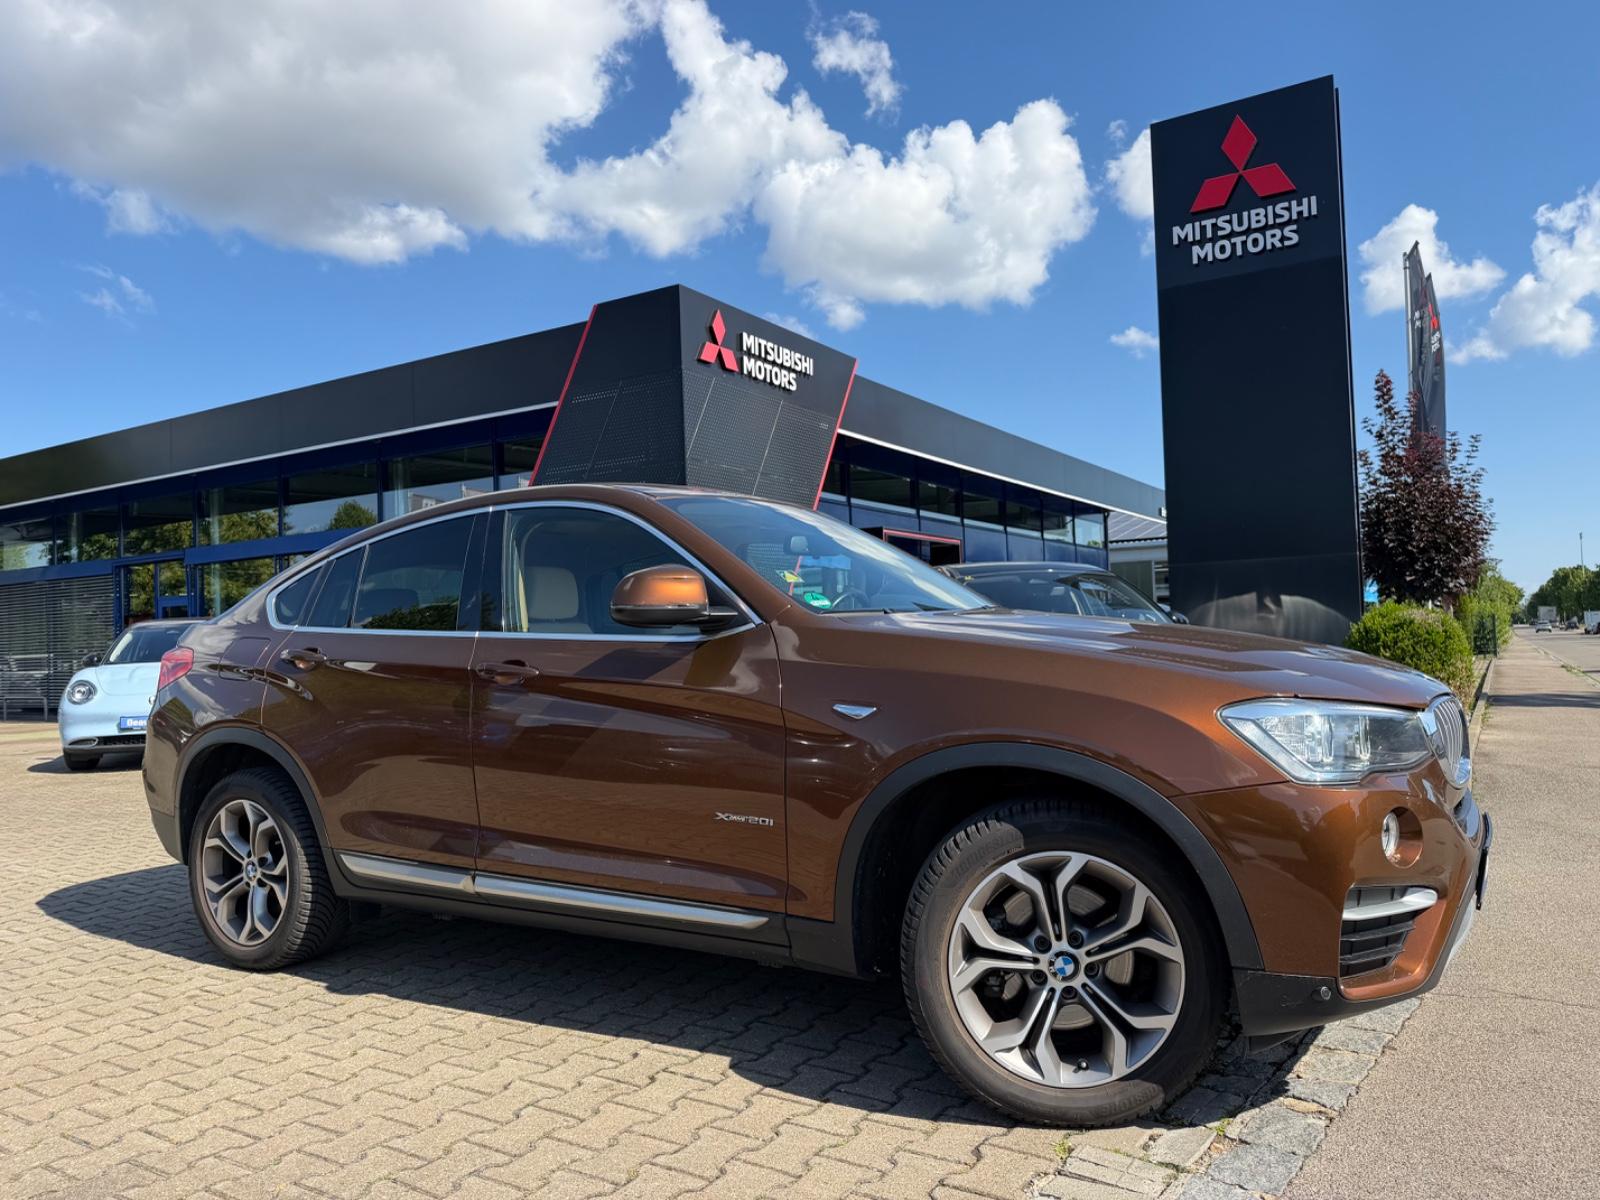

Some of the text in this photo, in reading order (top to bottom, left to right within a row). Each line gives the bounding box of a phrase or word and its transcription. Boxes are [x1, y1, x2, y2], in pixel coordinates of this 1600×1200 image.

[1172, 195, 1318, 246] MITSUBISHI
[1191, 224, 1299, 265] MOTORS
[742, 331, 814, 376] MITSUBISHI
[742, 356, 798, 391] MOTORS
